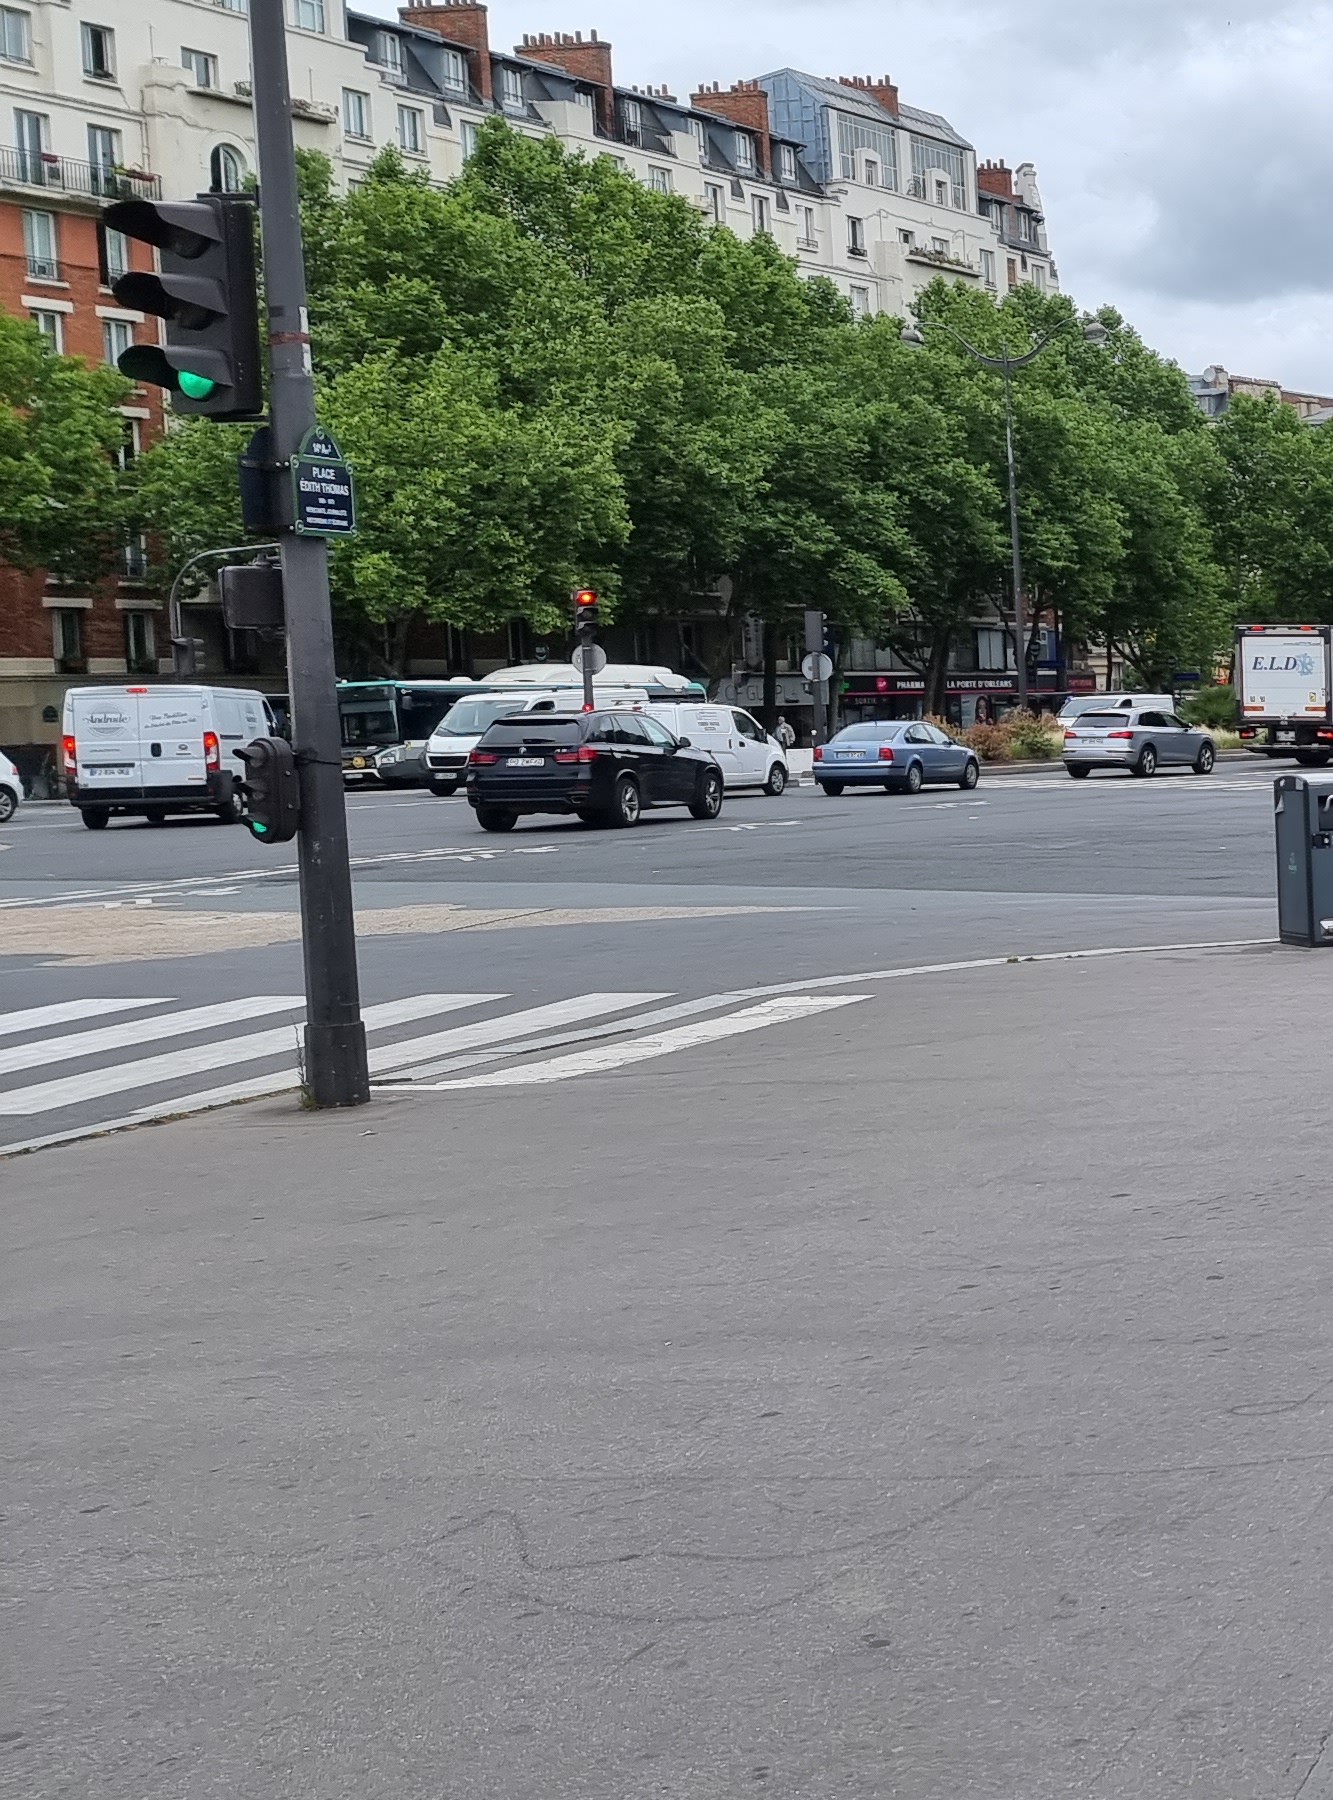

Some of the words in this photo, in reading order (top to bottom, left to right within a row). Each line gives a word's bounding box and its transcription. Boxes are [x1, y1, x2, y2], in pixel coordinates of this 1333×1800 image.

[312, 467, 335, 480] PLACE
[321, 483, 349, 496] THOMAS
[957, 680, 977, 688] PORTE
